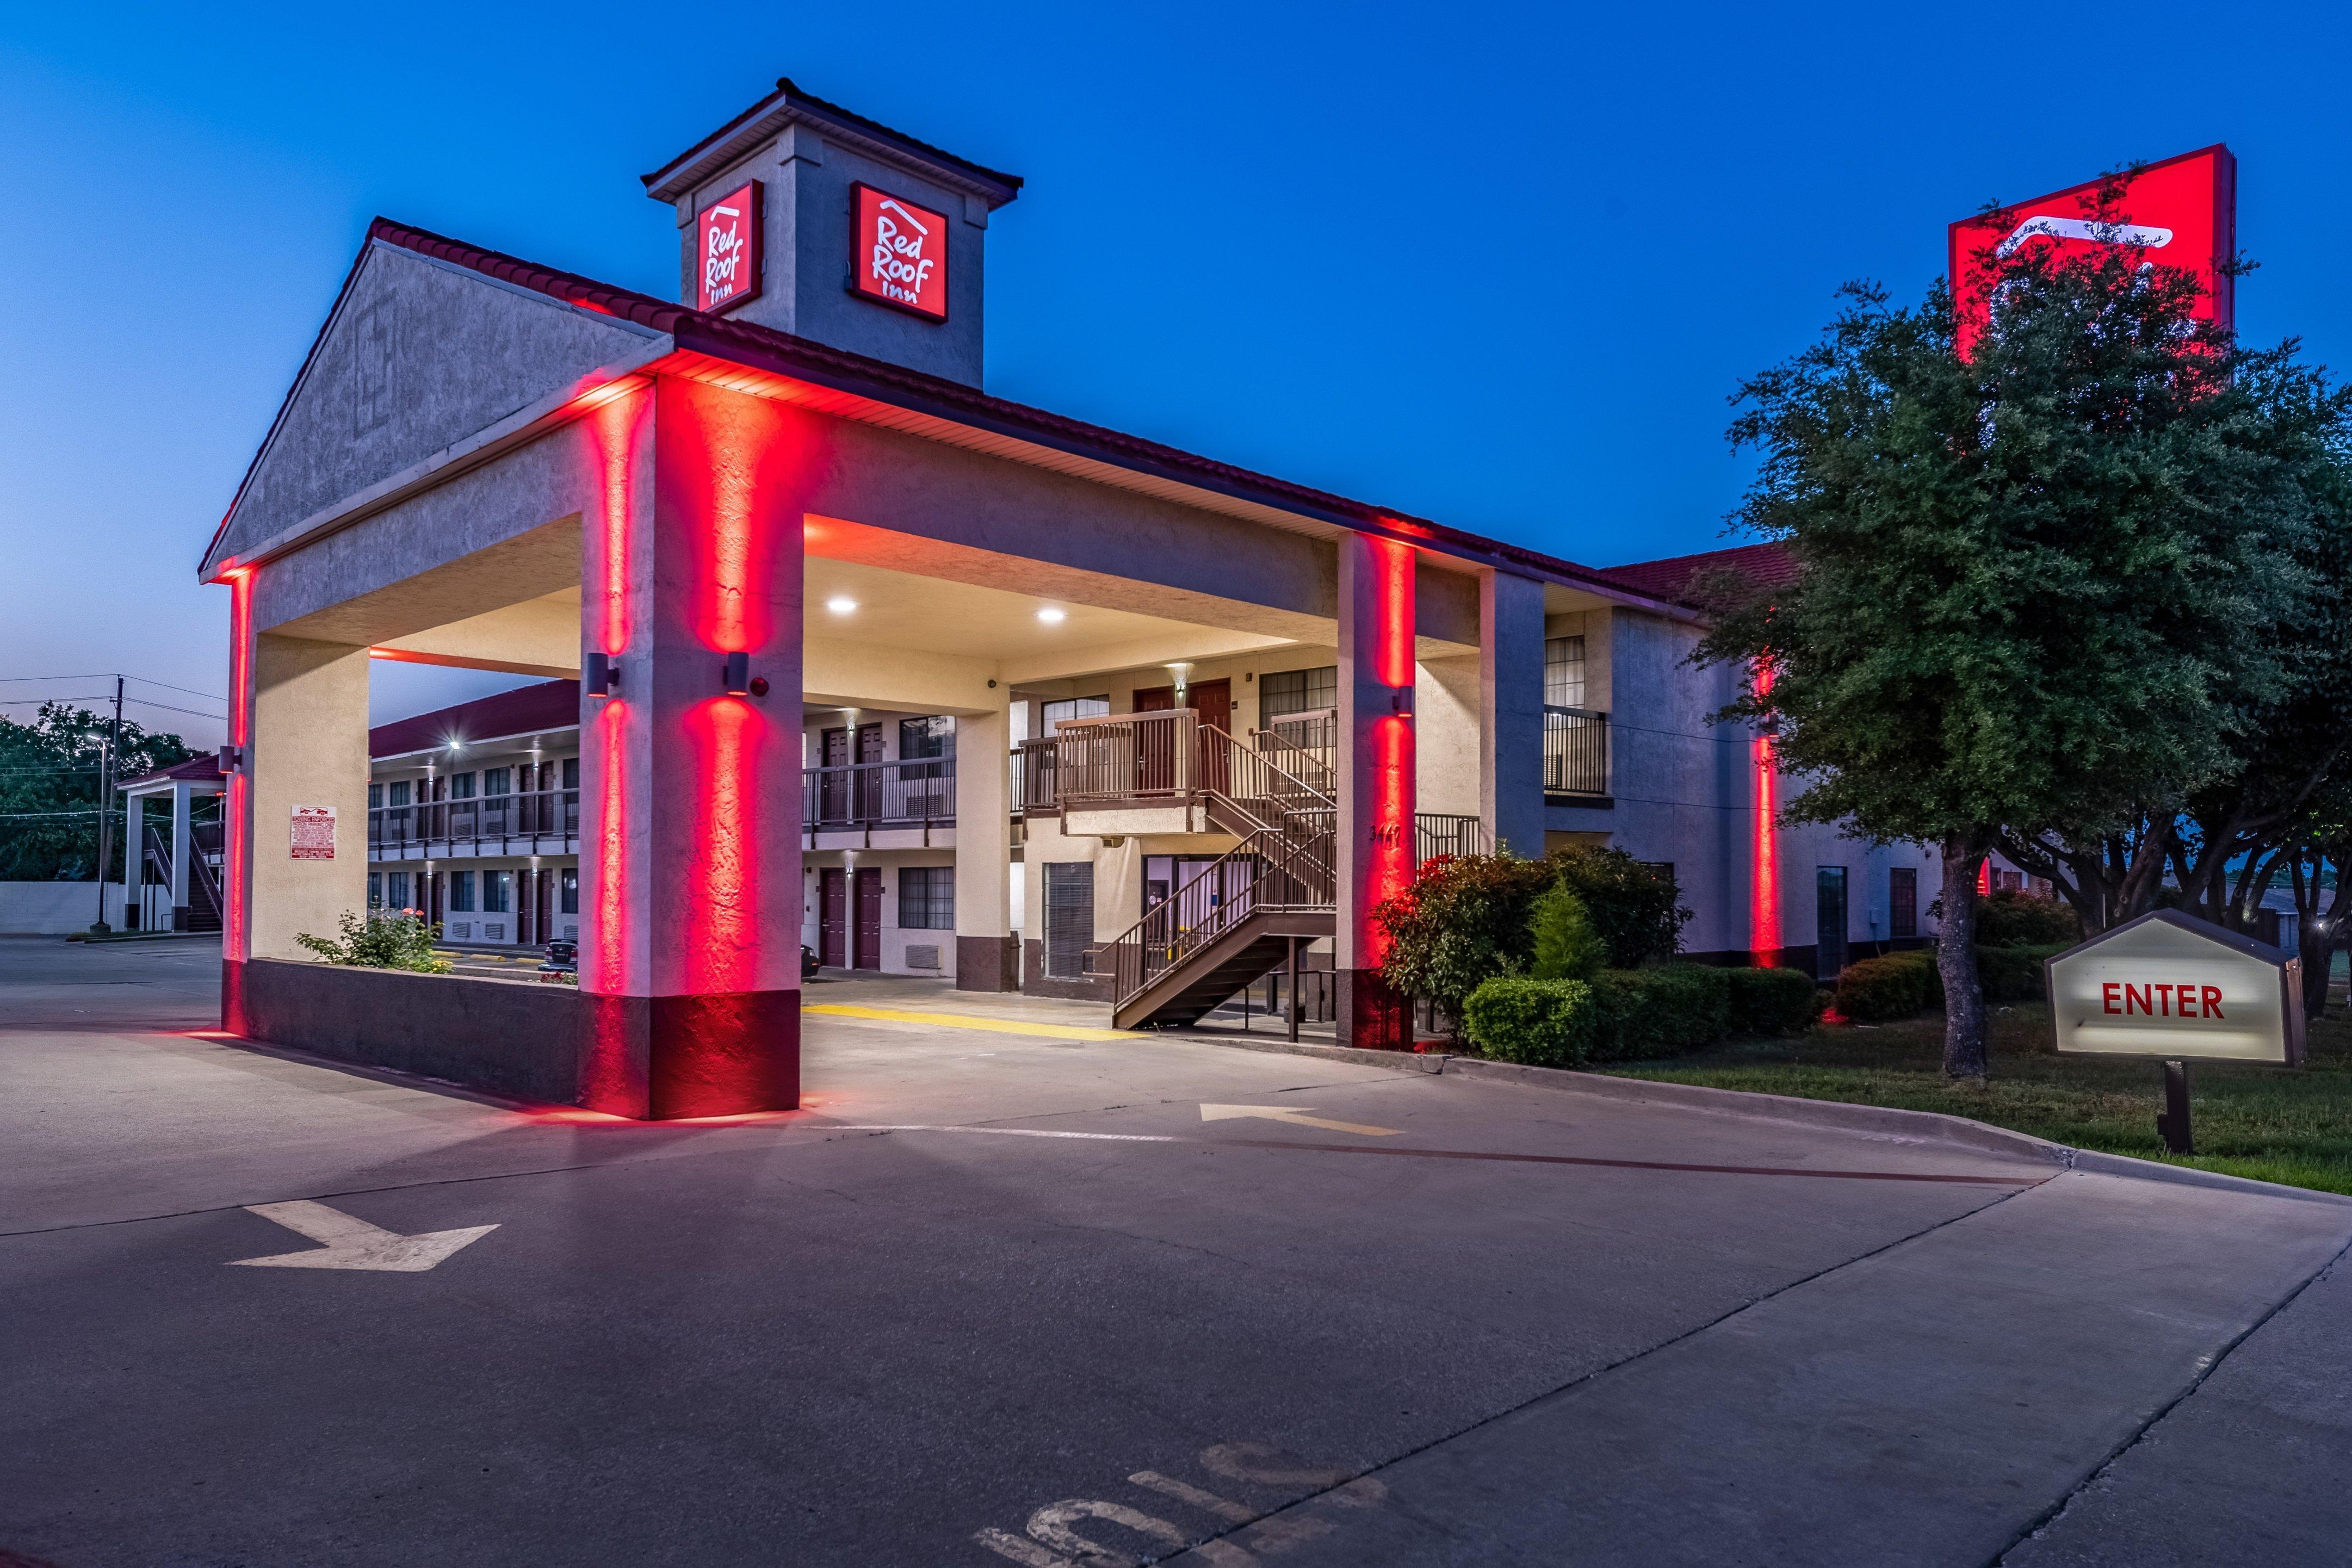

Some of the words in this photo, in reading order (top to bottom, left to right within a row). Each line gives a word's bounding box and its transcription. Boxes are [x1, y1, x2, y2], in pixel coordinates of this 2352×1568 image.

[709, 220, 736, 258] Red
[877, 215, 924, 259] Red
[705, 238, 744, 294] Roof
[872, 244, 934, 293] Roof
[2102, 982, 2225, 1019] ENTER
